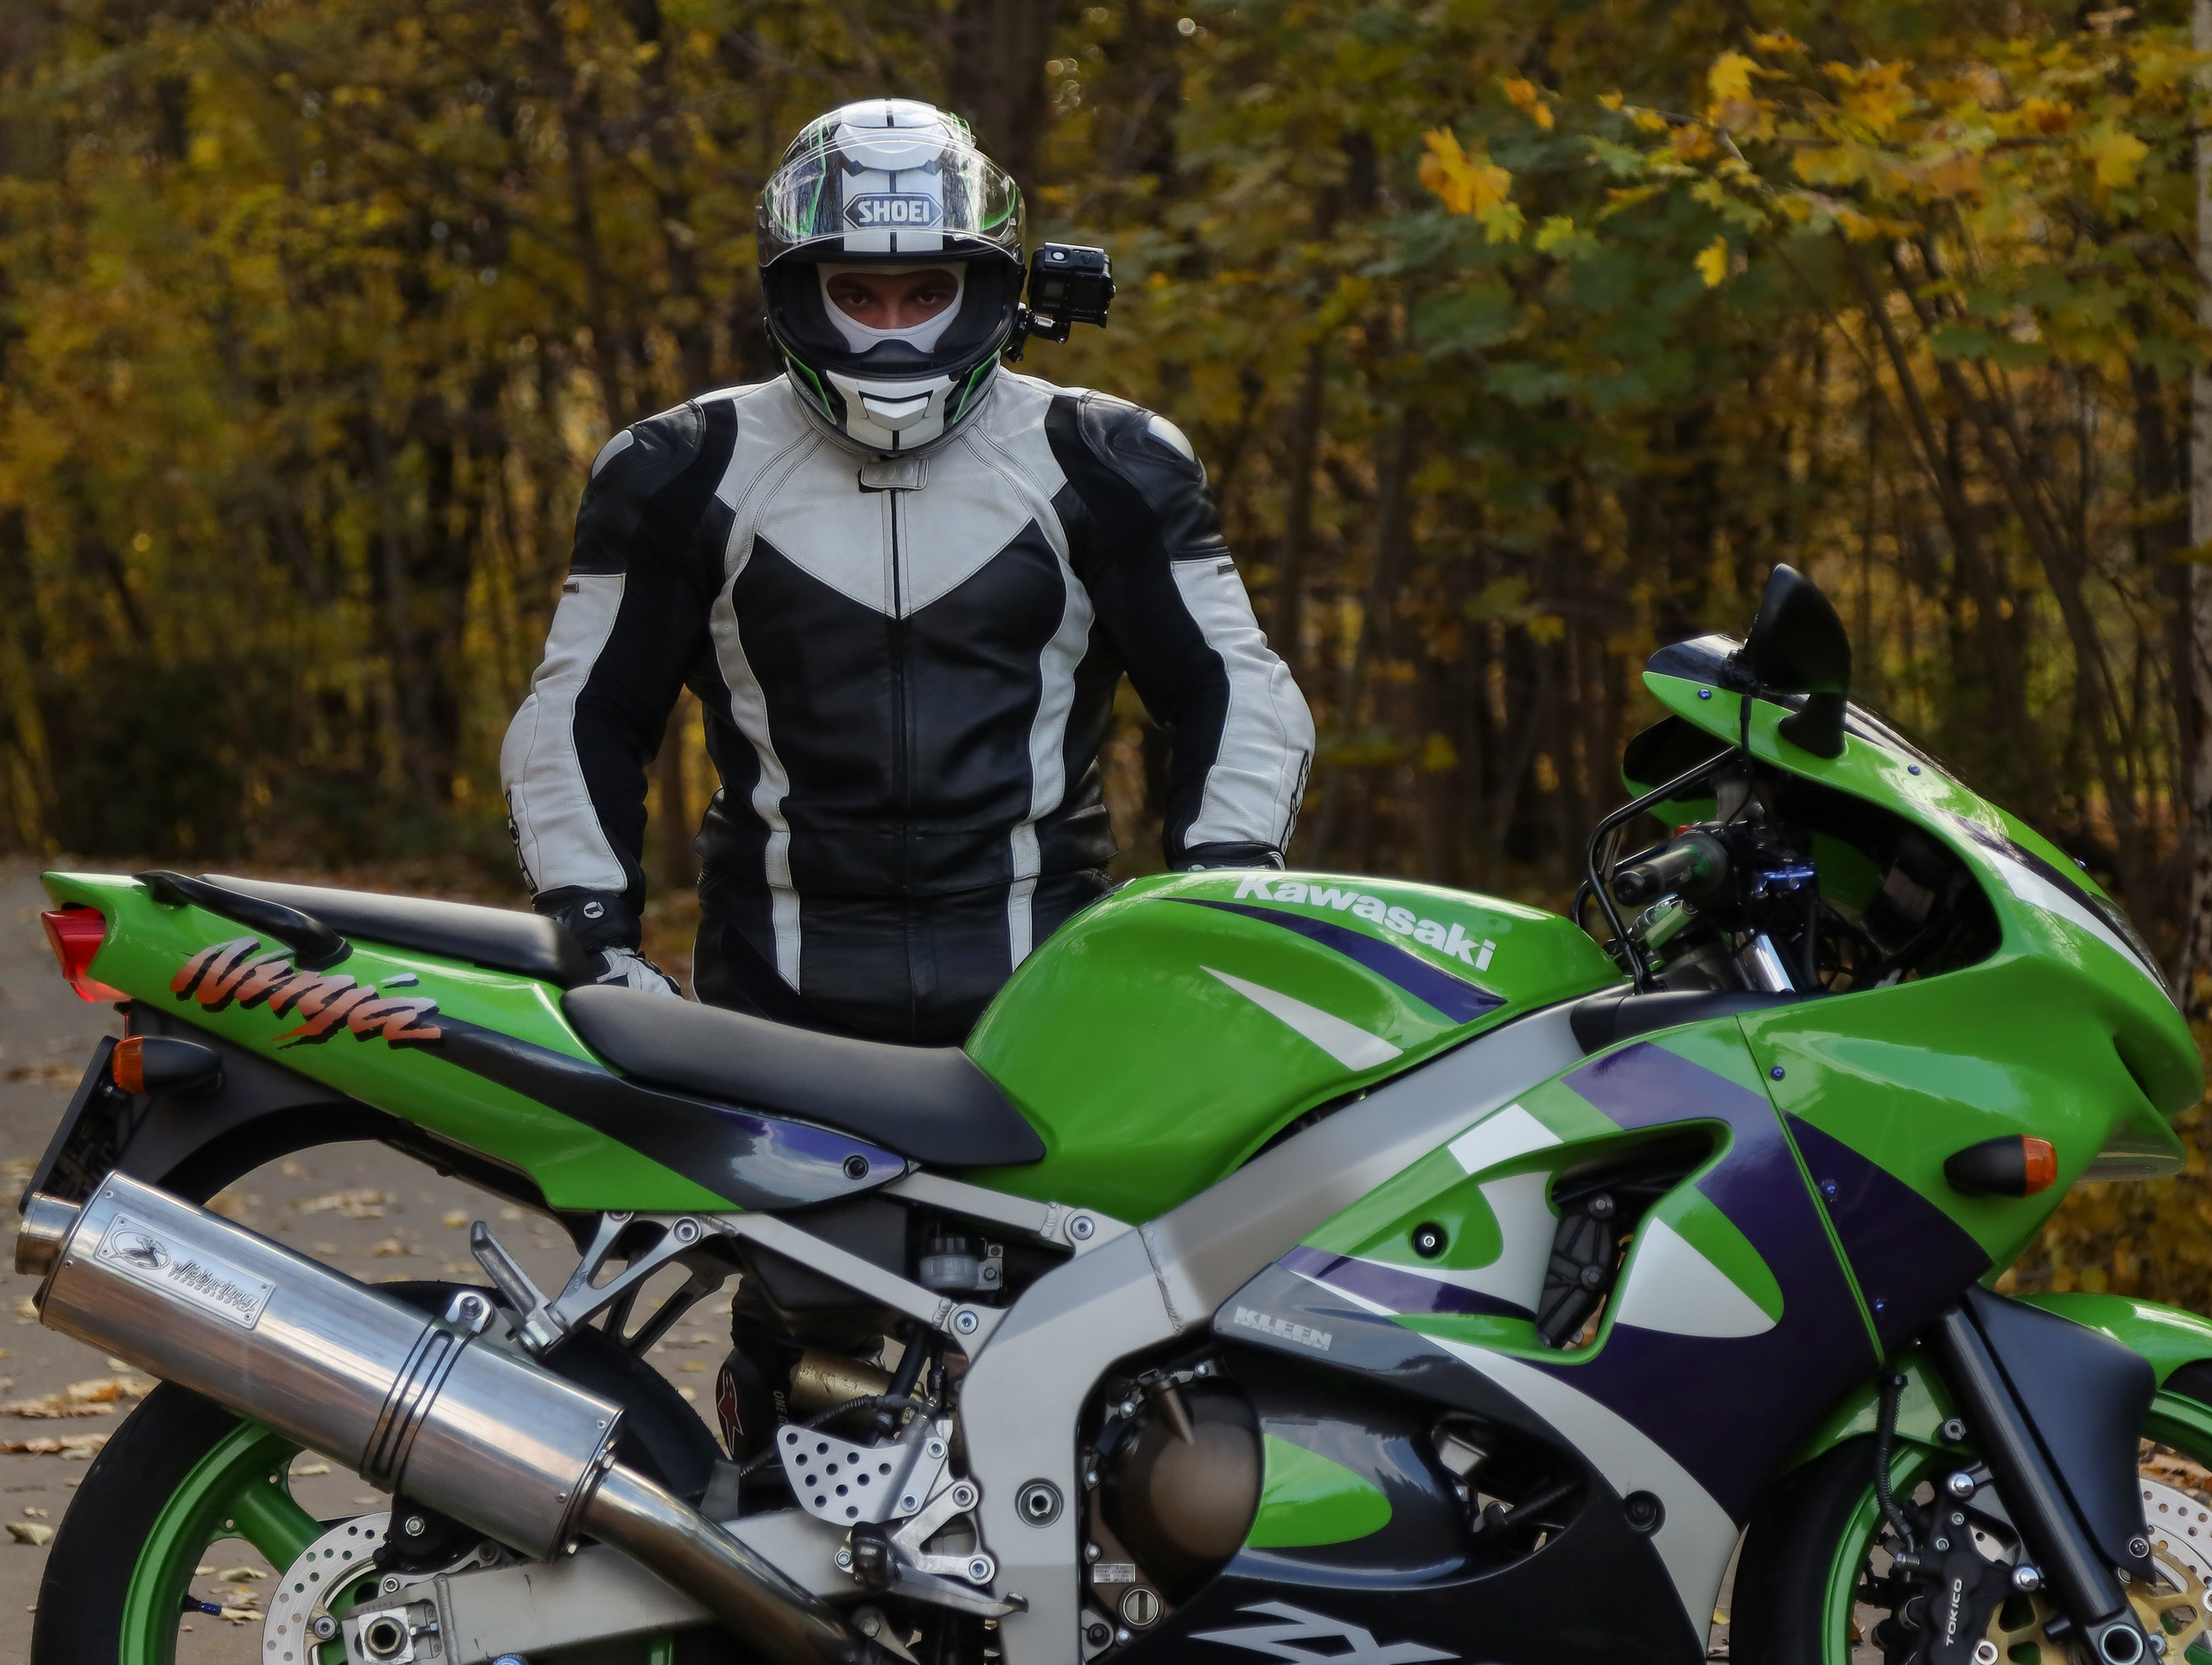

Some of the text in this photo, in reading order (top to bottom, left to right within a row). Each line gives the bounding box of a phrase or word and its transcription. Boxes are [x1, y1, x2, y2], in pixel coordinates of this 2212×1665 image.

[857, 200, 930, 223] SHOEI
[1234, 875, 1497, 972] Kawasaki
[169, 936, 444, 1047] Ninja
[1235, 1306, 1333, 1347] KLEEN
[773, 1390, 788, 1414] ONE
[1946, 1579, 1962, 1647] TOKICO
